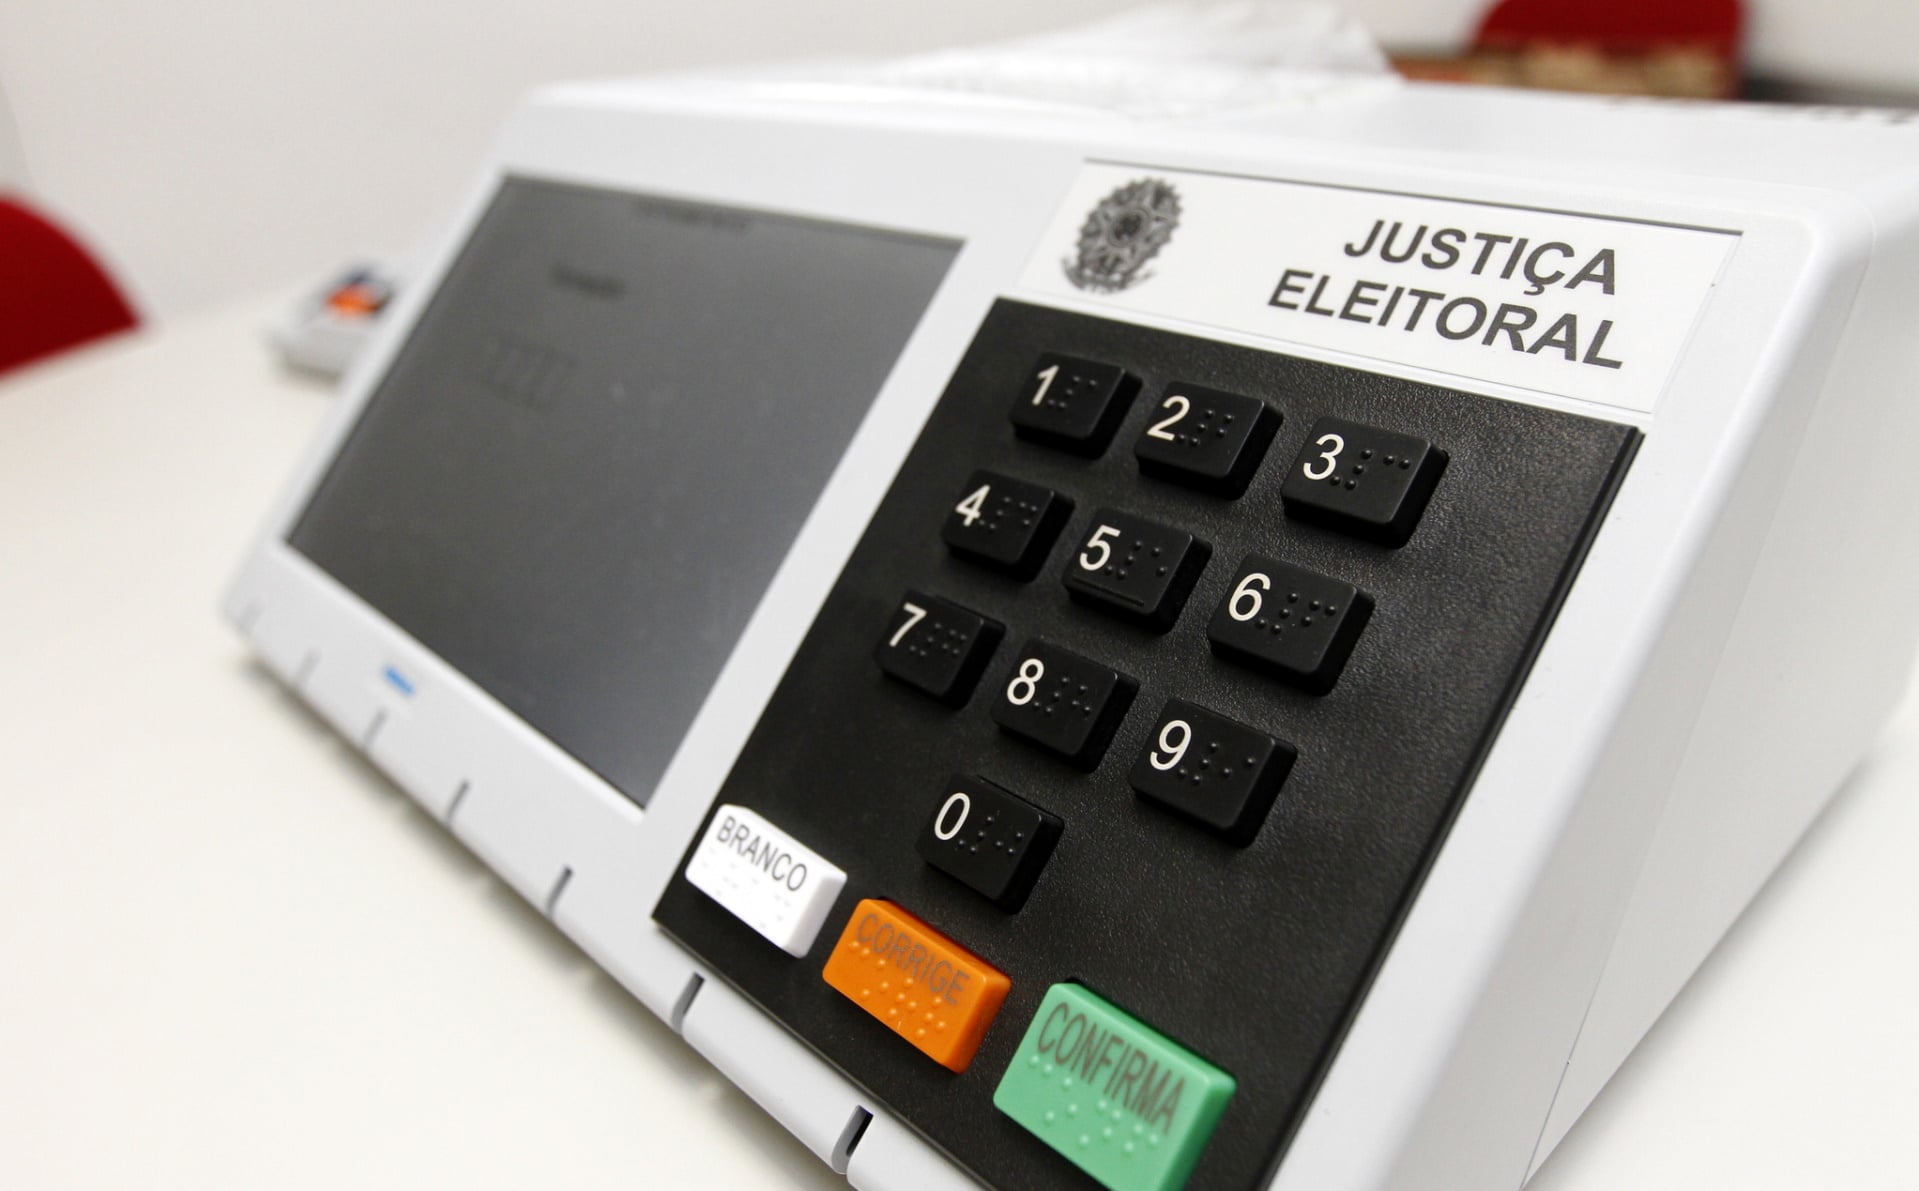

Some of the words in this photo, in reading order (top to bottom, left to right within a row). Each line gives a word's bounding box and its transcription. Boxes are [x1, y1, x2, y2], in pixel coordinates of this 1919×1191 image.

[1344, 219, 1617, 296] JUSTIÇA
[1267, 268, 1624, 369] ELEITORAL
[1032, 365, 1060, 405] 1
[1147, 396, 1190, 441] 2
[1303, 433, 1344, 480] 3
[955, 484, 991, 526] 4
[1079, 525, 1120, 571] 5
[1228, 572, 1271, 621] 6
[889, 603, 926, 647] 7
[1006, 658, 1045, 704] 8
[1150, 719, 1192, 770] 9
[934, 792, 970, 840] 0
[716, 817, 808, 892] BRANCO
[856, 913, 970, 1006] CORRIGE
[1037, 1002, 1184, 1134] CONFIRMA
